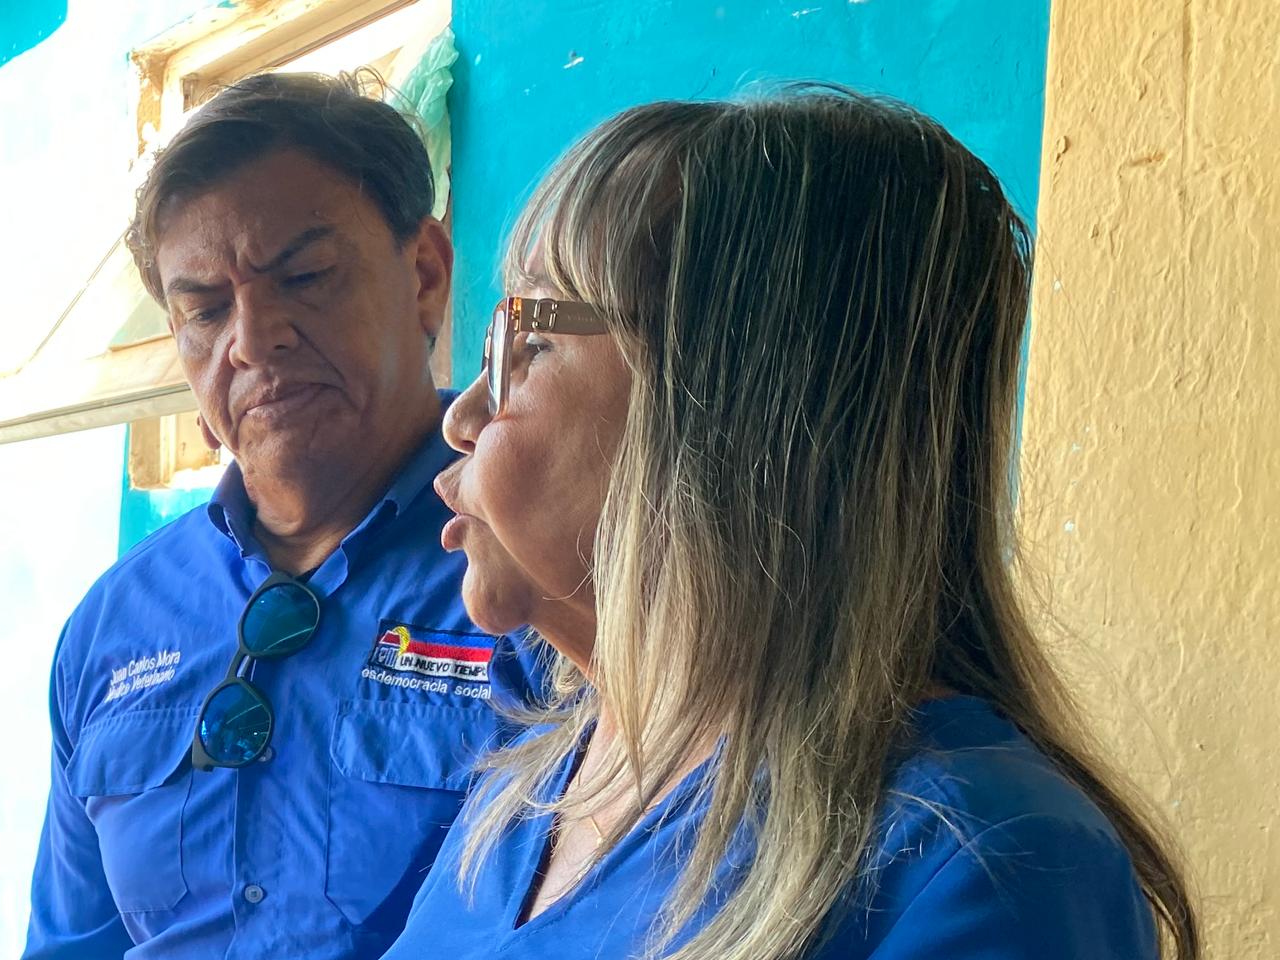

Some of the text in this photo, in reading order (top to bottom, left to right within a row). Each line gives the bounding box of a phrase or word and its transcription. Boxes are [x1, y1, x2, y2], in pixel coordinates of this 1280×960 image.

[128, 656, 156, 677] Carlos
[156, 649, 181, 668] Mora
[400, 655, 414, 667] UN
[415, 658, 450, 673] NUEVO
[454, 685, 492, 700] social
